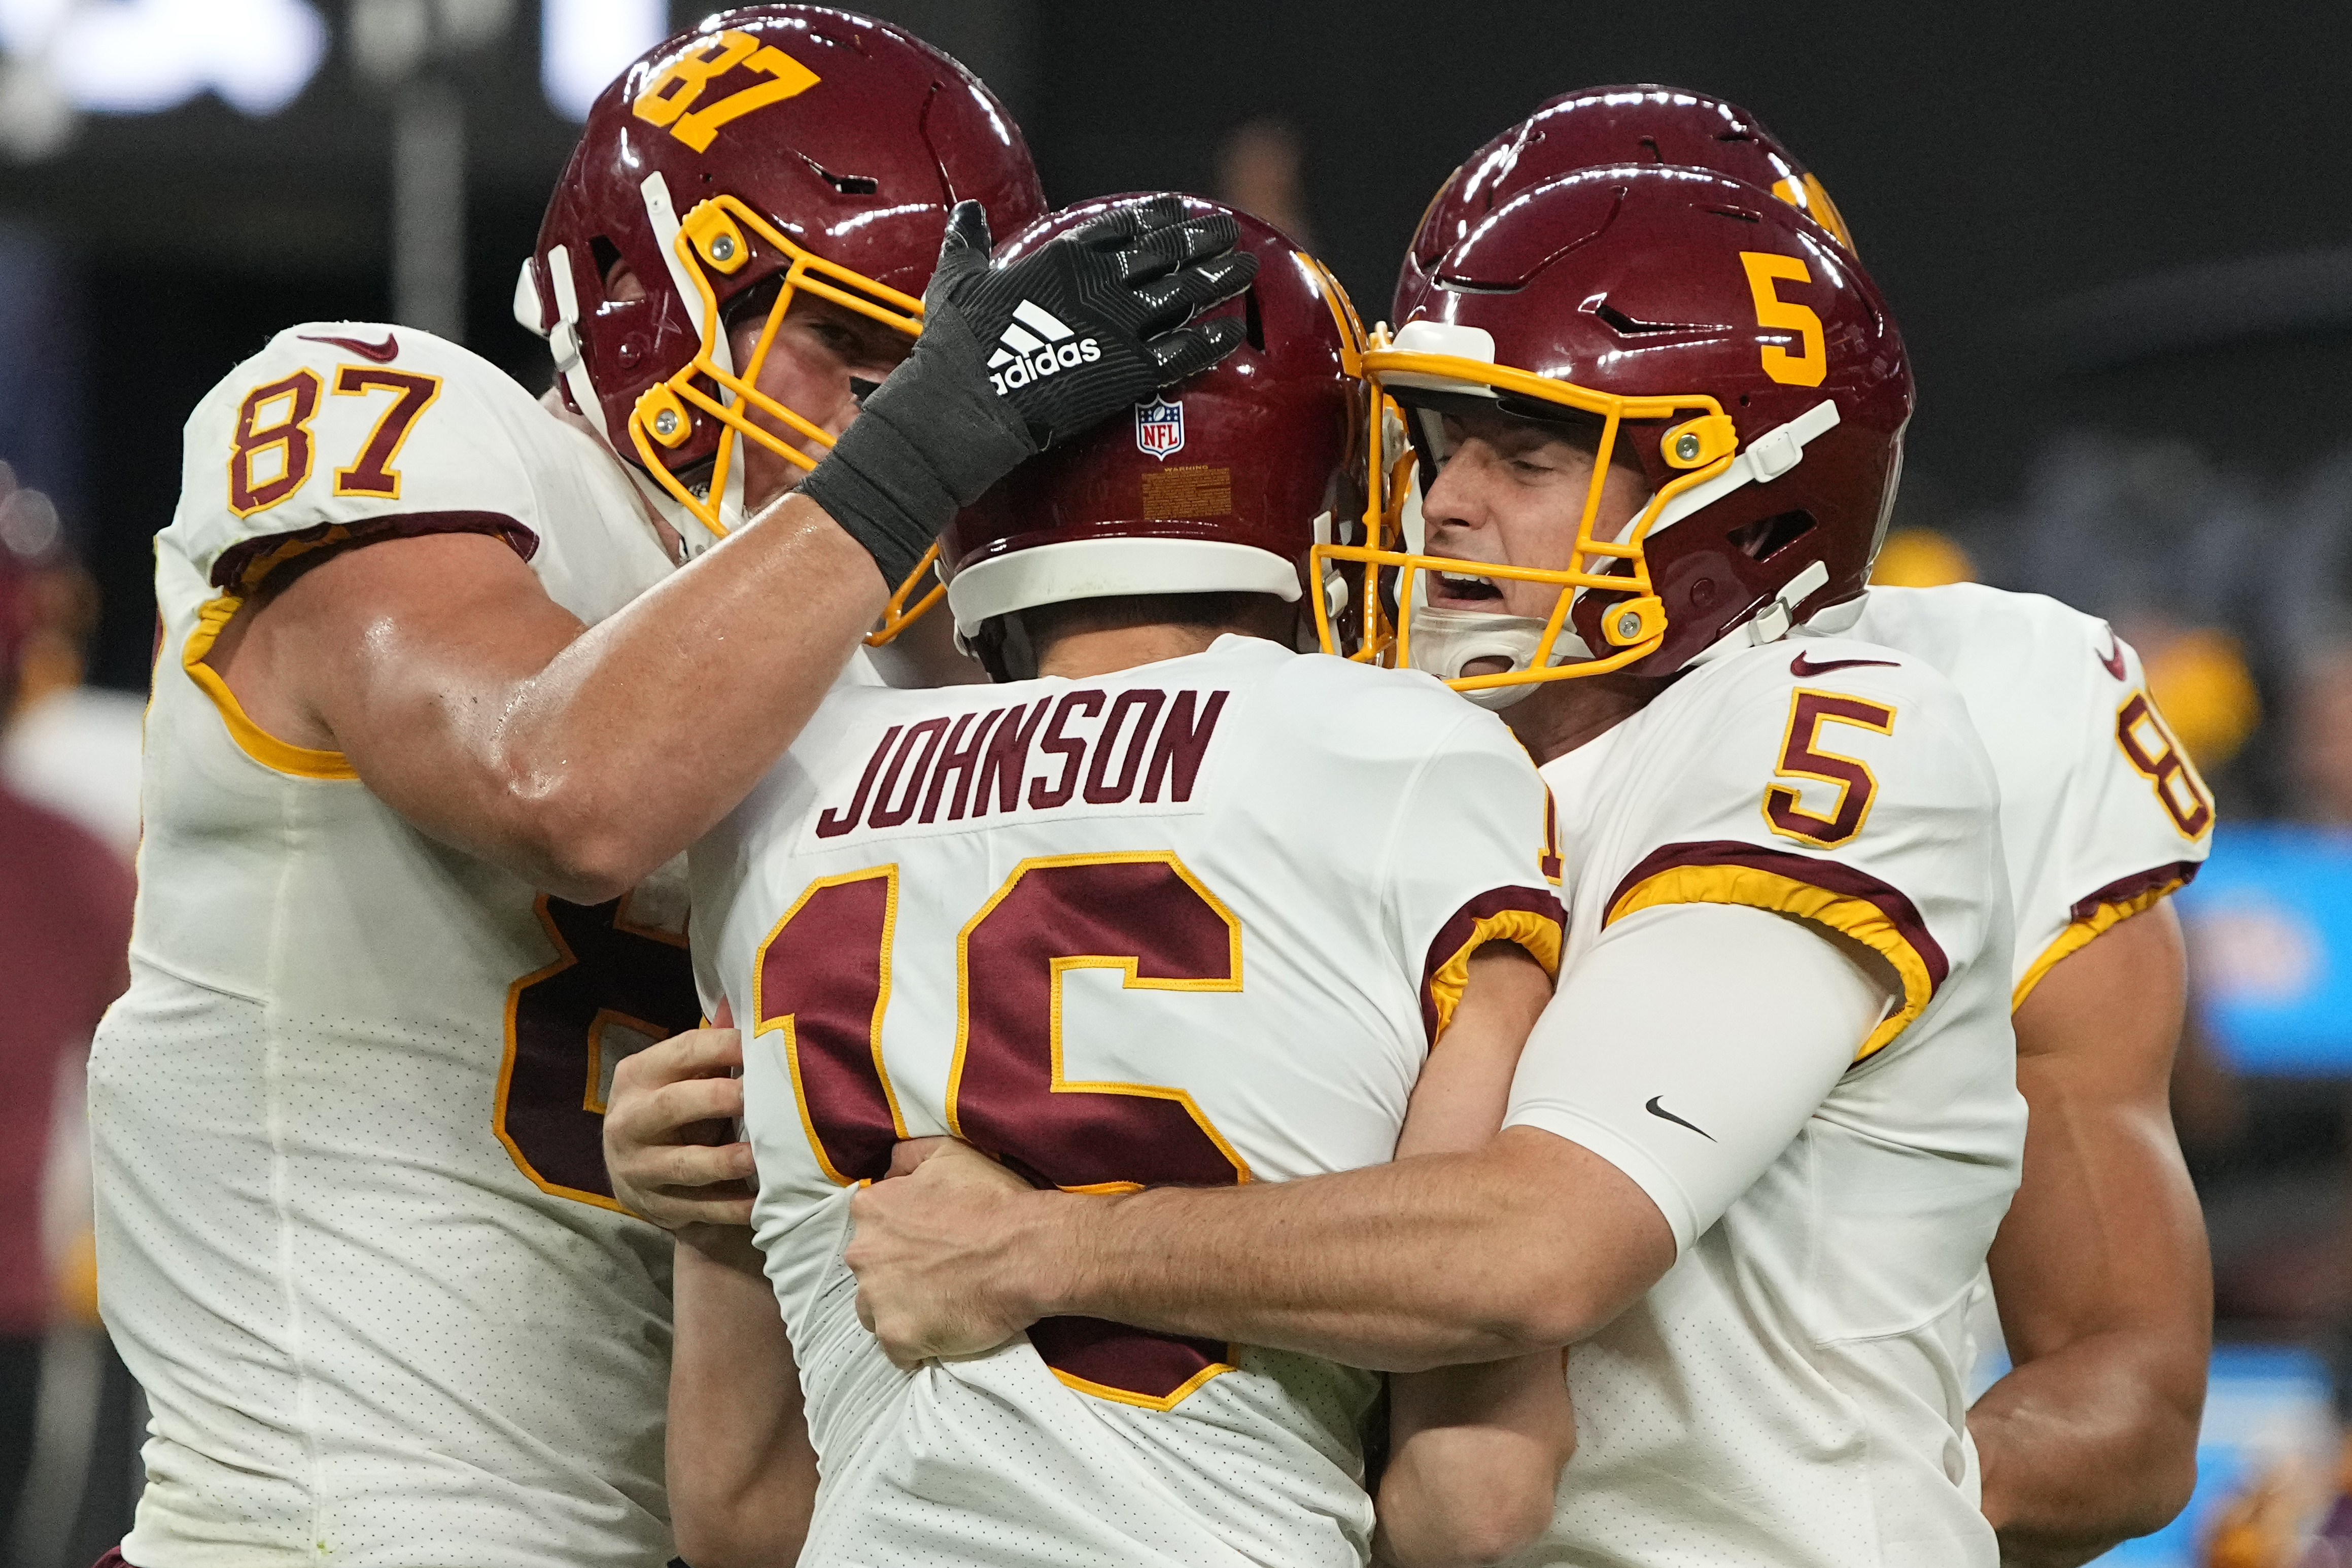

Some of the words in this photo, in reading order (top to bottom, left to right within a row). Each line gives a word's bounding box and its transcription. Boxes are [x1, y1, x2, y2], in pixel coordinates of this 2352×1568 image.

[632, 29, 821, 154] 87
[1739, 251, 1827, 388] 5
[227, 363, 443, 520] 87
[1143, 424, 1178, 449] NFL
[816, 689, 1230, 839] JOHNSON
[1761, 686, 1897, 850] 5
[753, 850, 1251, 1412] 16
